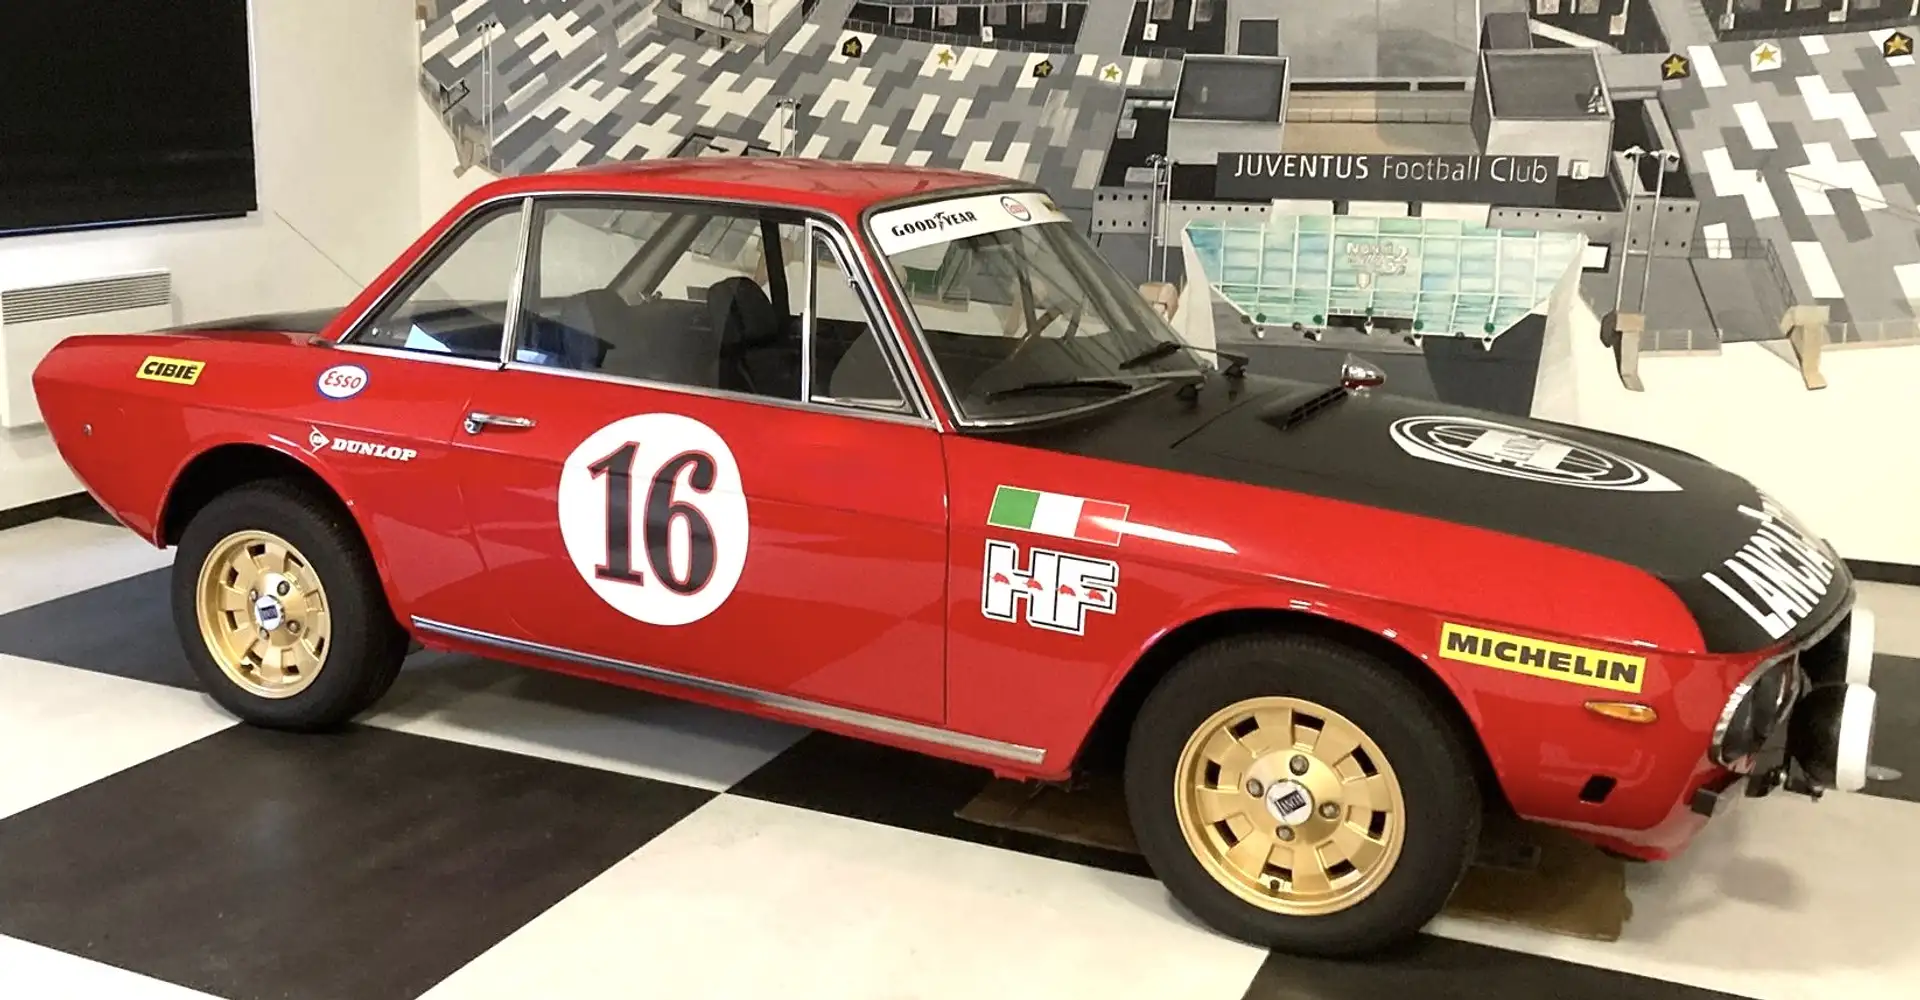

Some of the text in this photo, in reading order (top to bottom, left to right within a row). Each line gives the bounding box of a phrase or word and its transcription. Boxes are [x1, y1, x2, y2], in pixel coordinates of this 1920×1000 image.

[1235, 154, 1548, 184] JUVENTUS Football Club
[331, 437, 417, 462] DUNLOP
[587, 441, 717, 596] 16
[982, 540, 1118, 635] HF
[1446, 631, 1638, 684] MICHELIN
